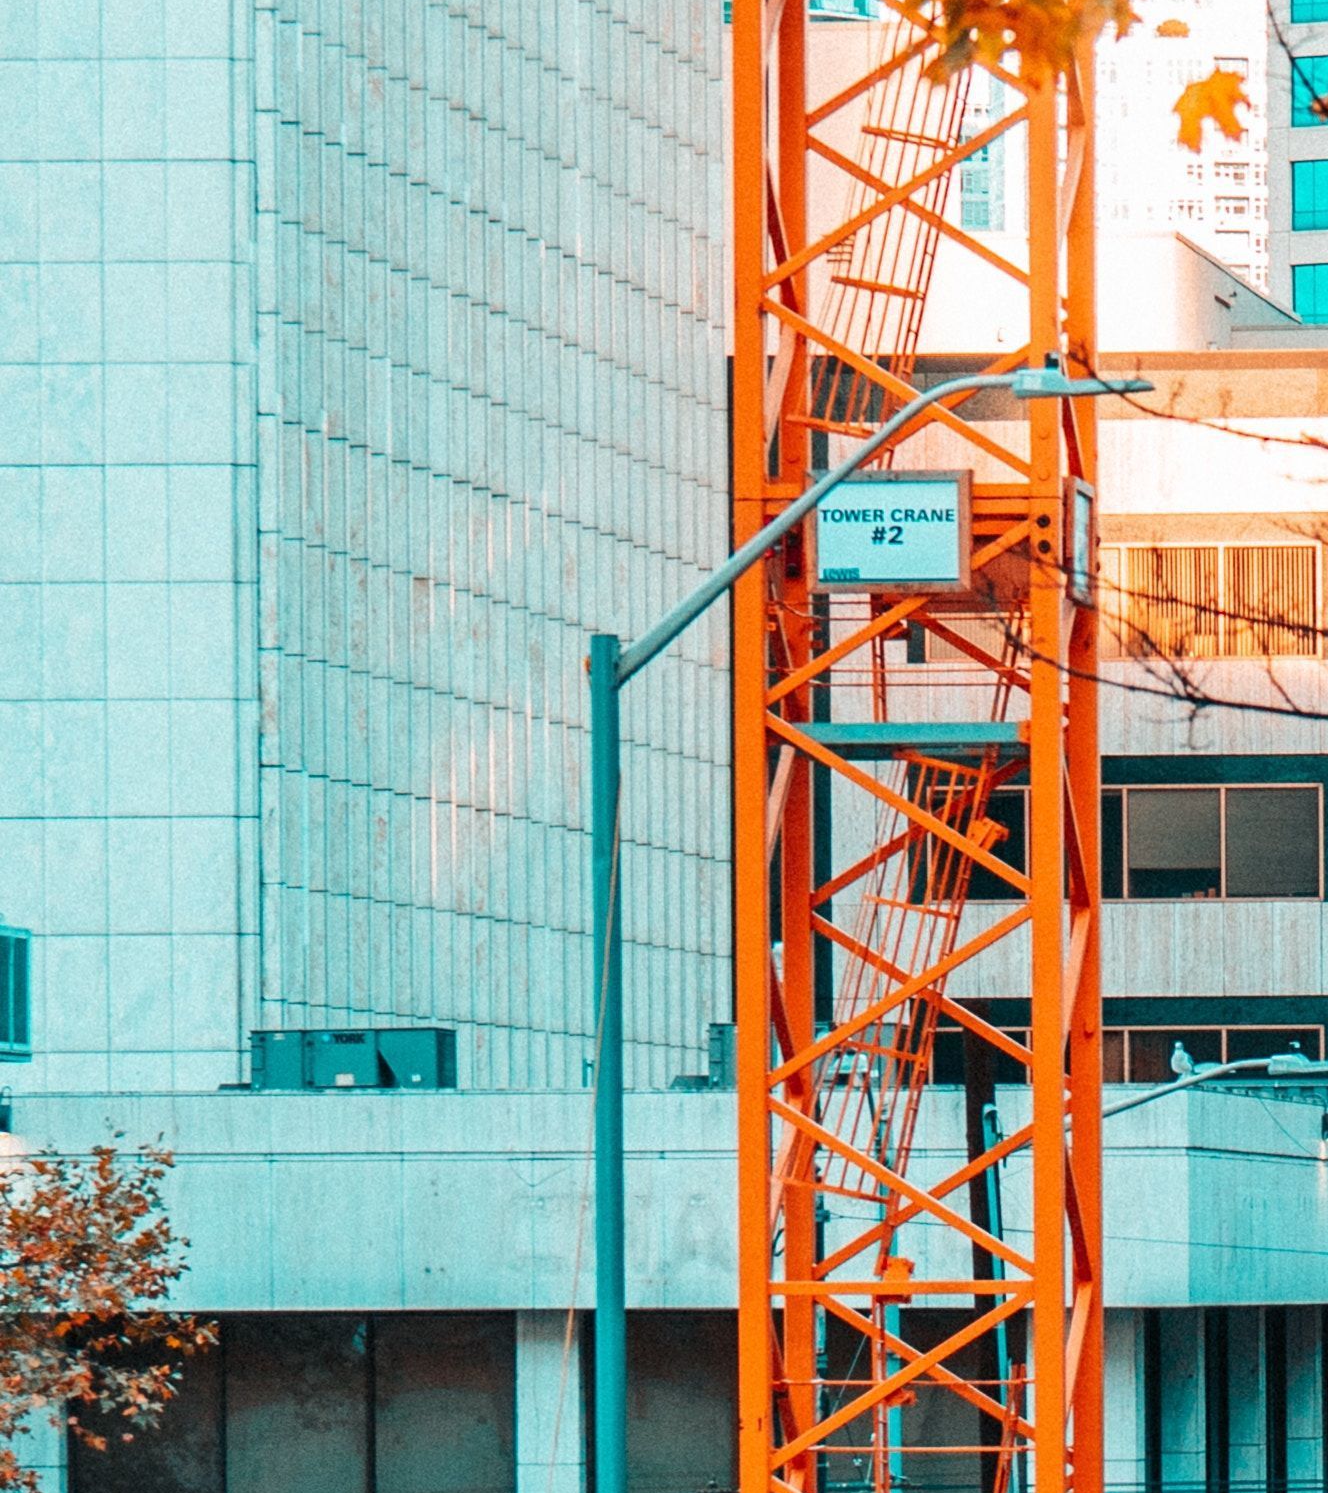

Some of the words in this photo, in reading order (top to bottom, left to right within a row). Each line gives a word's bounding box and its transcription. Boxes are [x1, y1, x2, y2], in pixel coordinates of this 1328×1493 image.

[820, 508, 884, 523] TOWER
[890, 508, 955, 523] CRANE
[871, 526, 904, 545] #2
[332, 1033, 365, 1044] YORK
